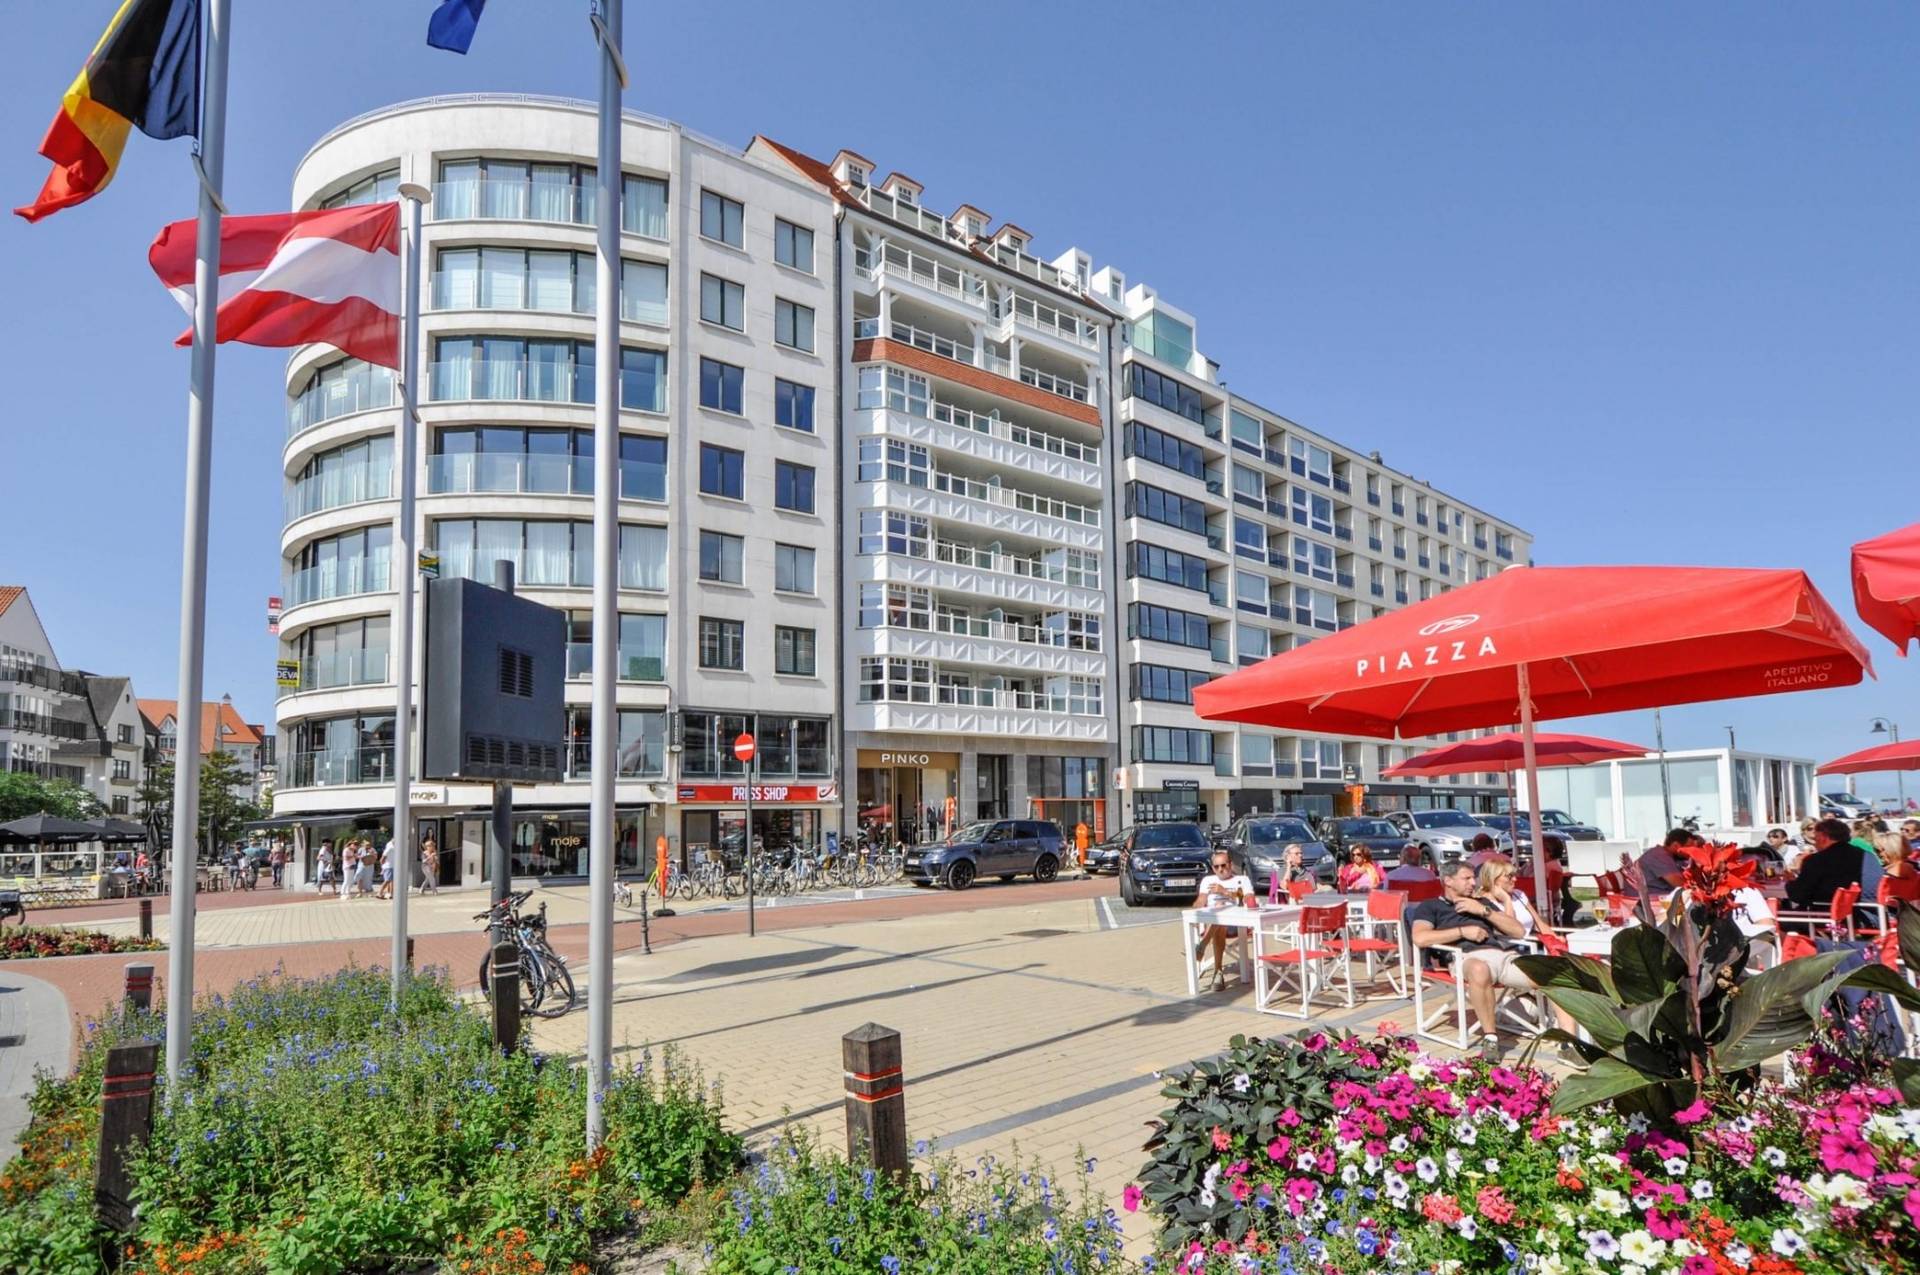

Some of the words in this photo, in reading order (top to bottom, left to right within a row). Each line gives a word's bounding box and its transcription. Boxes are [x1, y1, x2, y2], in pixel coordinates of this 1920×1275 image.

[1357, 636, 1497, 677] PIAZZA
[1764, 662, 1833, 678] APERITIVO
[1767, 673, 1829, 688] ITALIANO
[881, 753, 929, 765] PINKO
[410, 791, 438, 801] maje
[763, 786, 788, 801] SHOP
[550, 835, 581, 848] maje
